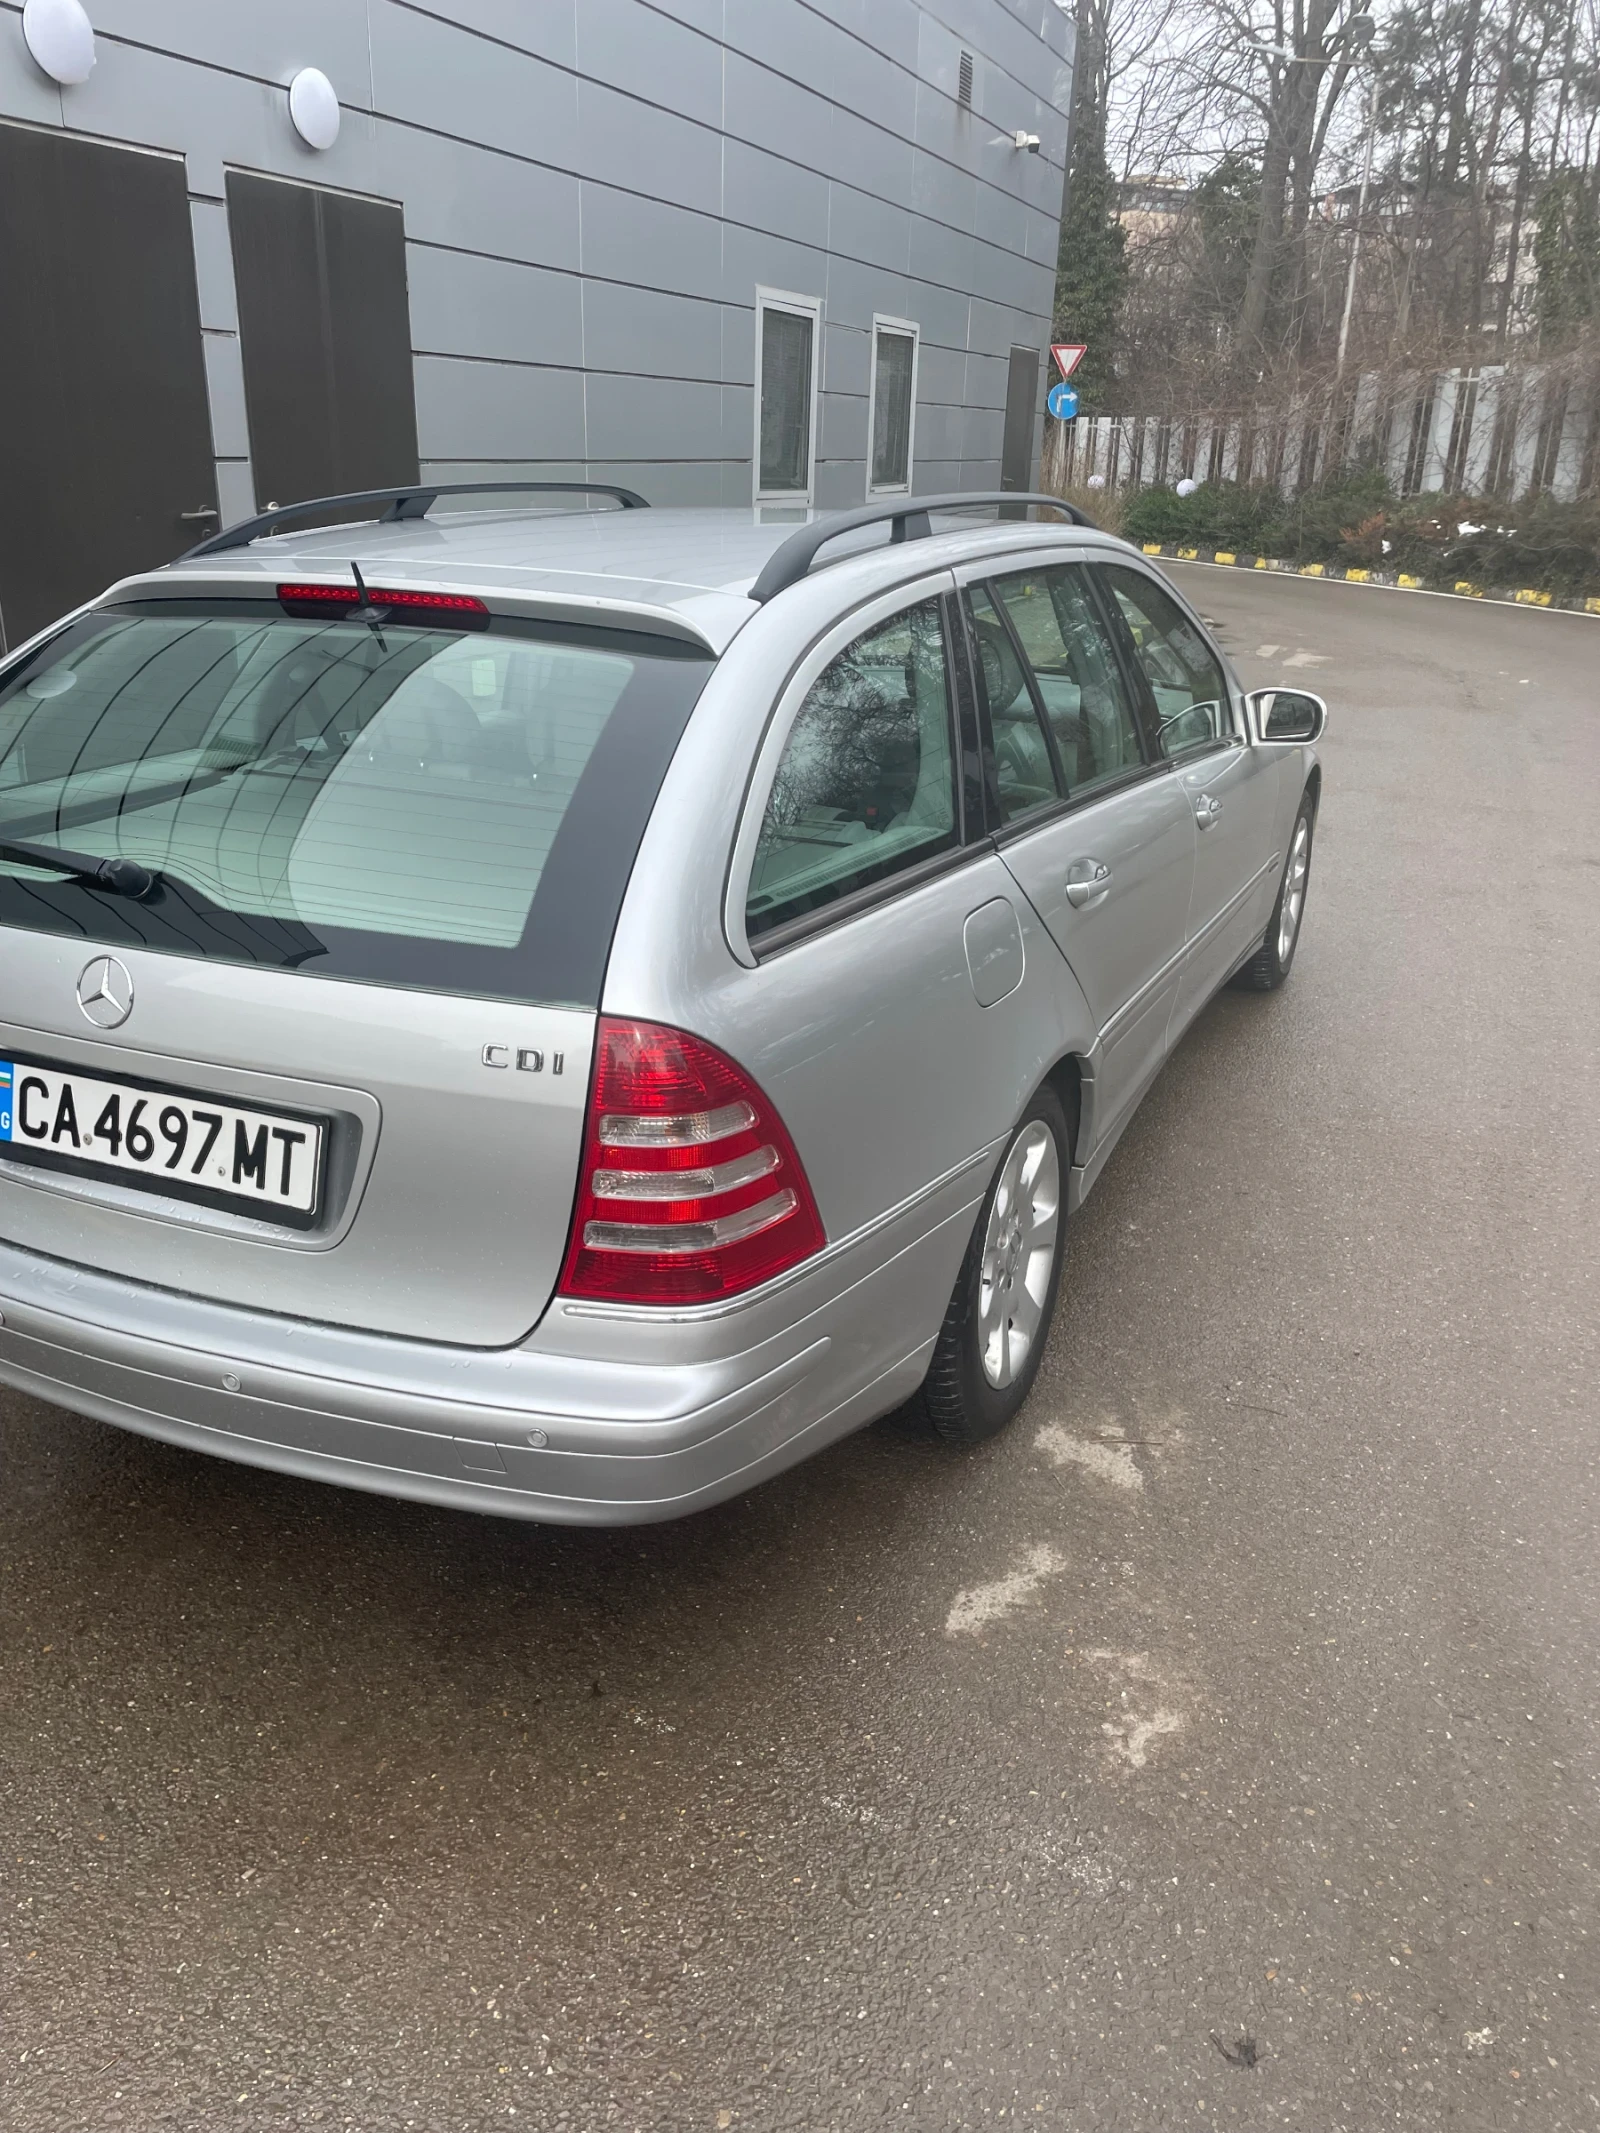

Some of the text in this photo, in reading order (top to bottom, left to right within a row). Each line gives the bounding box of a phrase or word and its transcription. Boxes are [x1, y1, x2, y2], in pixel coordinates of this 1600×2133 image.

[482, 1043, 564, 1075] CDI
[18, 1076, 306, 1196] CA 4697 MT
